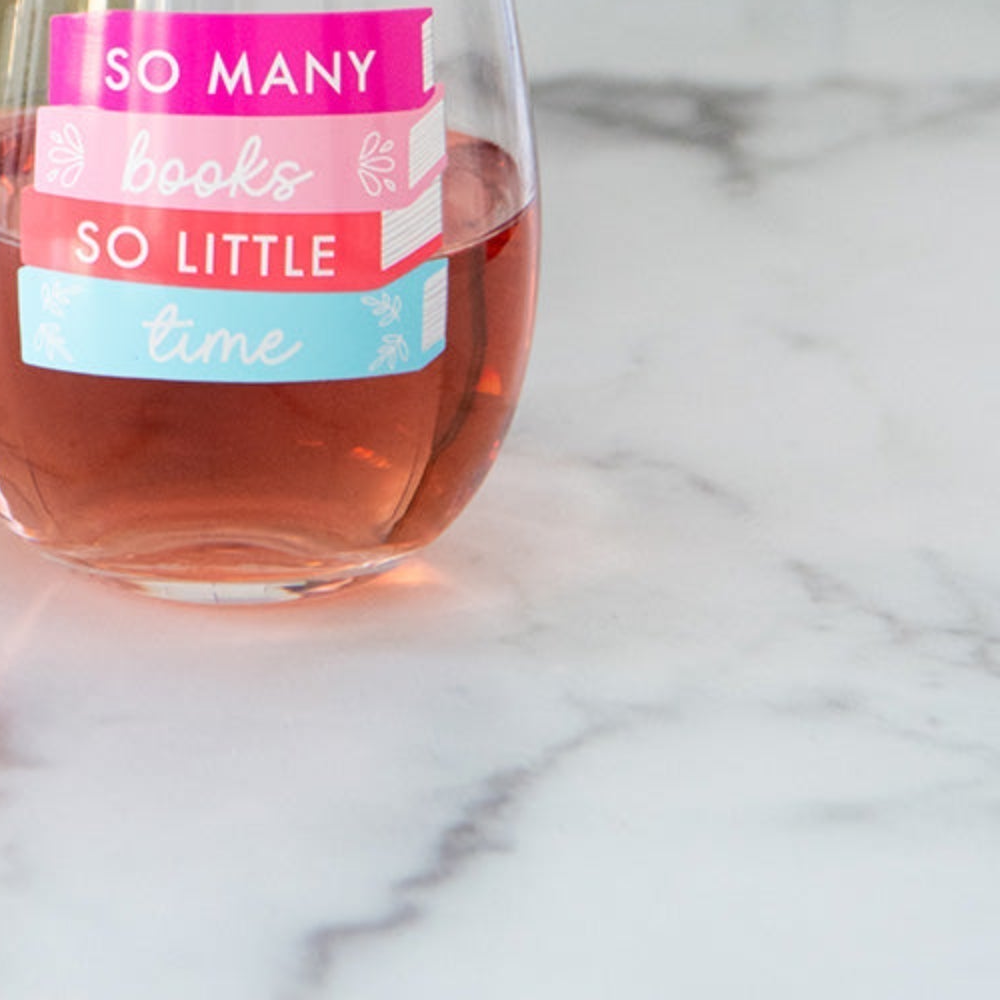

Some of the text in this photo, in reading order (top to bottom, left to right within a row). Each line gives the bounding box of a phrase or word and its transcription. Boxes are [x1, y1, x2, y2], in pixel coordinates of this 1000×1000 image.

[104, 47, 376, 96] SO MANY
[121, 129, 315, 202] books
[74, 220, 337, 278] SO LITTLE
[141, 303, 303, 366] time
